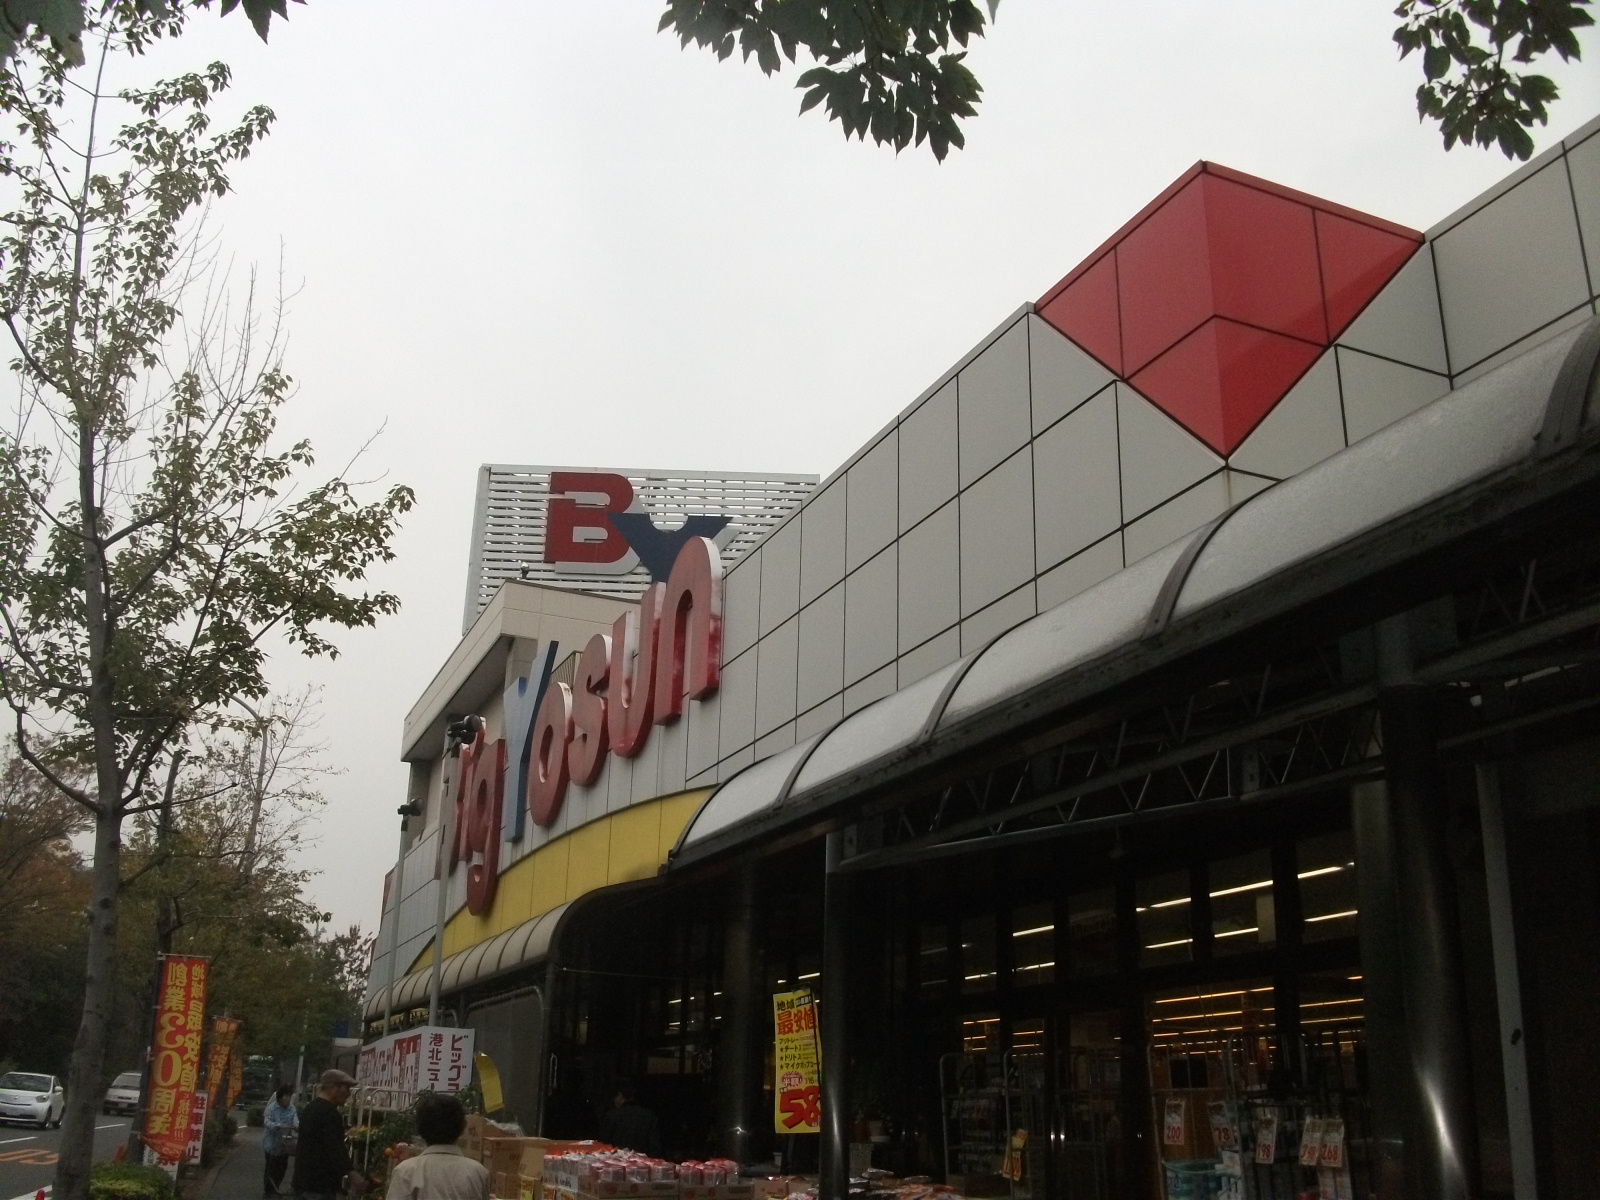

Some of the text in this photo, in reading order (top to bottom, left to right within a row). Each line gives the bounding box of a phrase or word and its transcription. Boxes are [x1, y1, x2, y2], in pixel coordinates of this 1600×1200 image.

[777, 1006, 817, 1035] 最安値
[780, 1086, 821, 1129] 58
